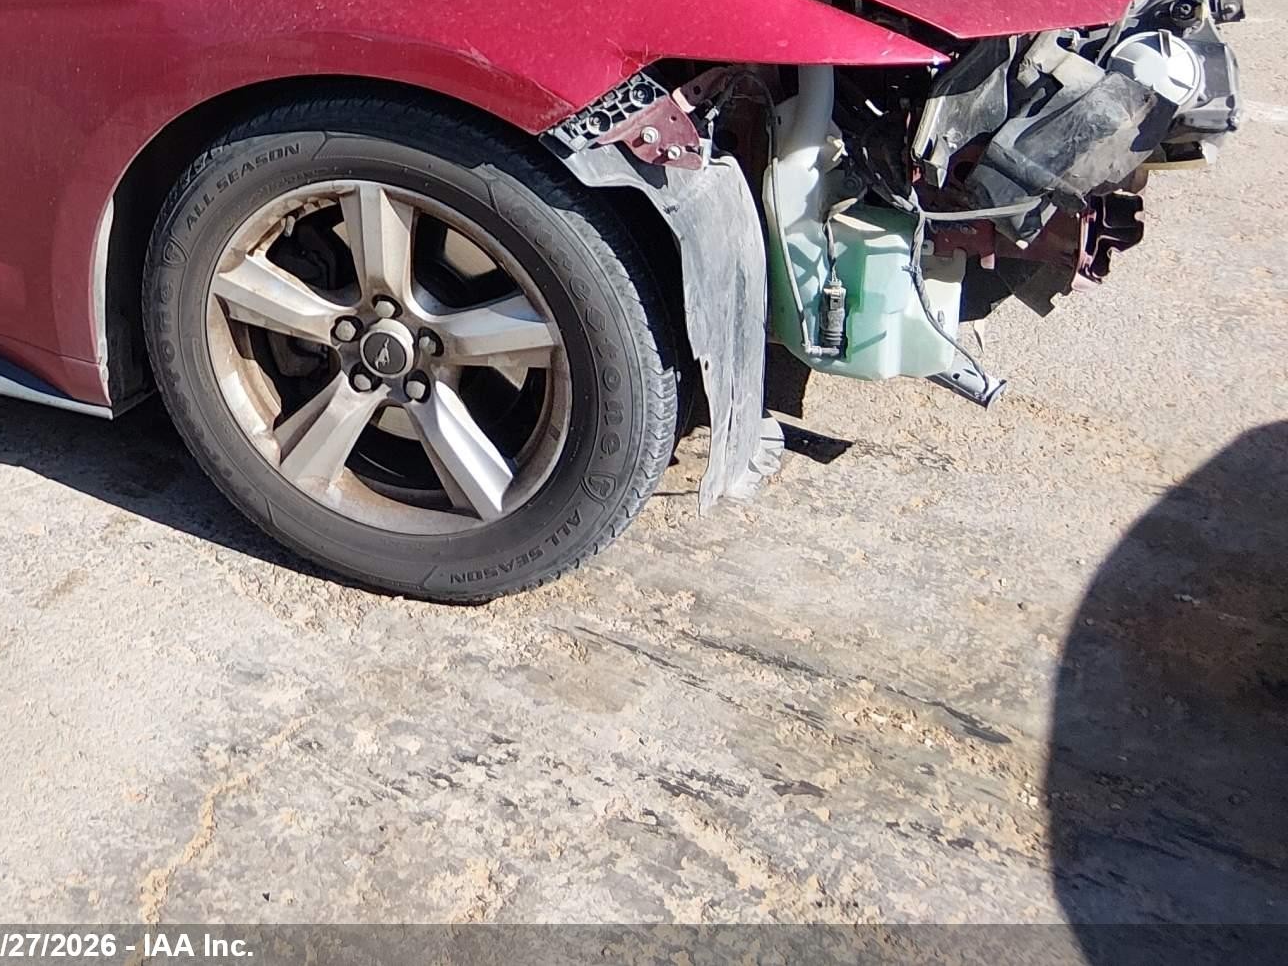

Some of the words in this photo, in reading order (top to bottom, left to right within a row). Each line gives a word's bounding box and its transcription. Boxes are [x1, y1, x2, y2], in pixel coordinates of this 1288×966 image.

[185, 192, 215, 232] ALL
[216, 142, 301, 194] SEASON
[545, 508, 582, 547] ALL
[449, 545, 545, 584] SEASON
